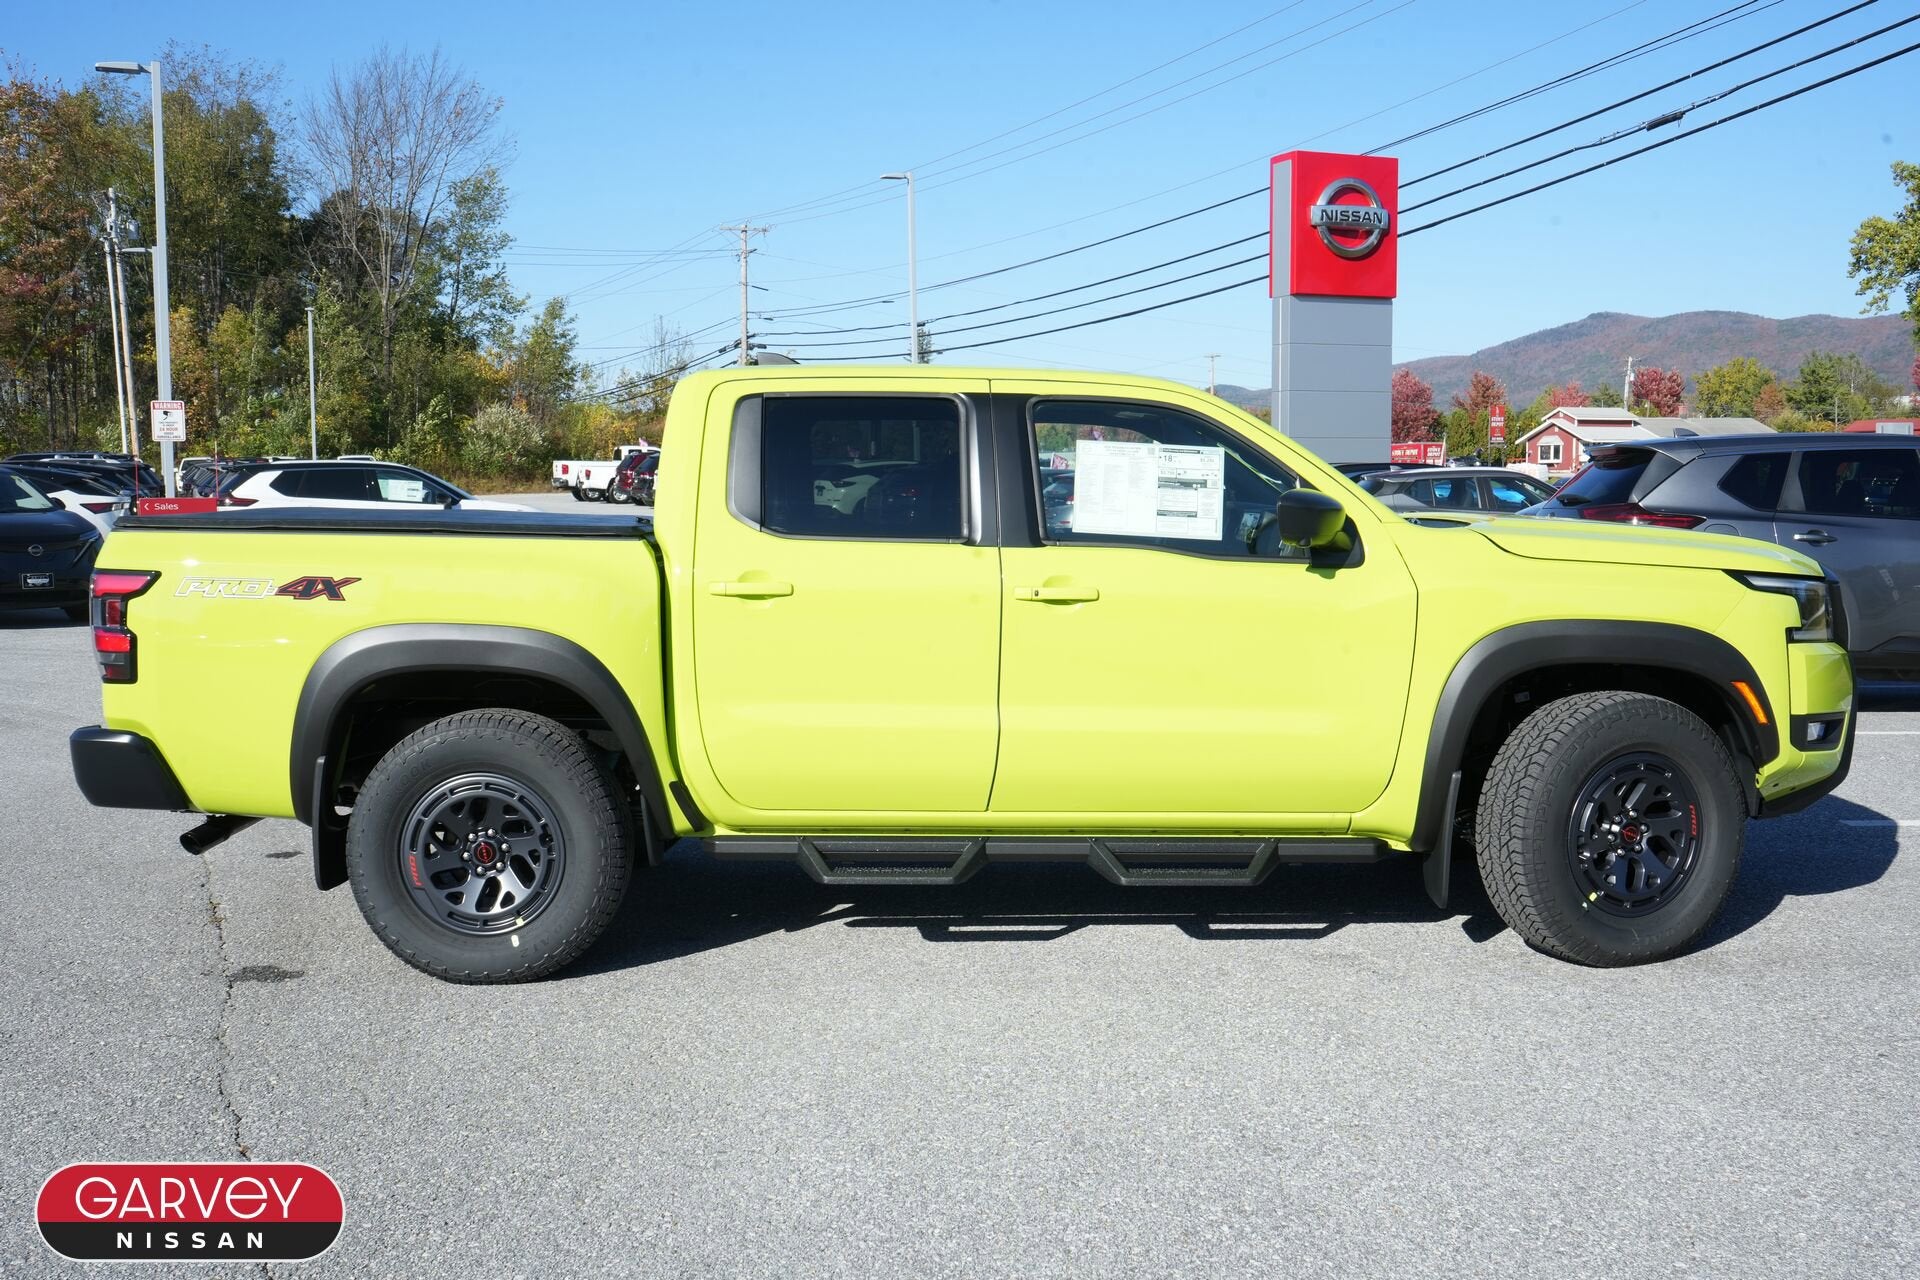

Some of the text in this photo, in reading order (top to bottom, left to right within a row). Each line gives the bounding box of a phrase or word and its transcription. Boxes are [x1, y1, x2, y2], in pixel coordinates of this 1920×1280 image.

[1320, 208, 1384, 224] NISSAN
[154, 402, 182, 410] WARNING
[154, 502, 179, 511] Sales
